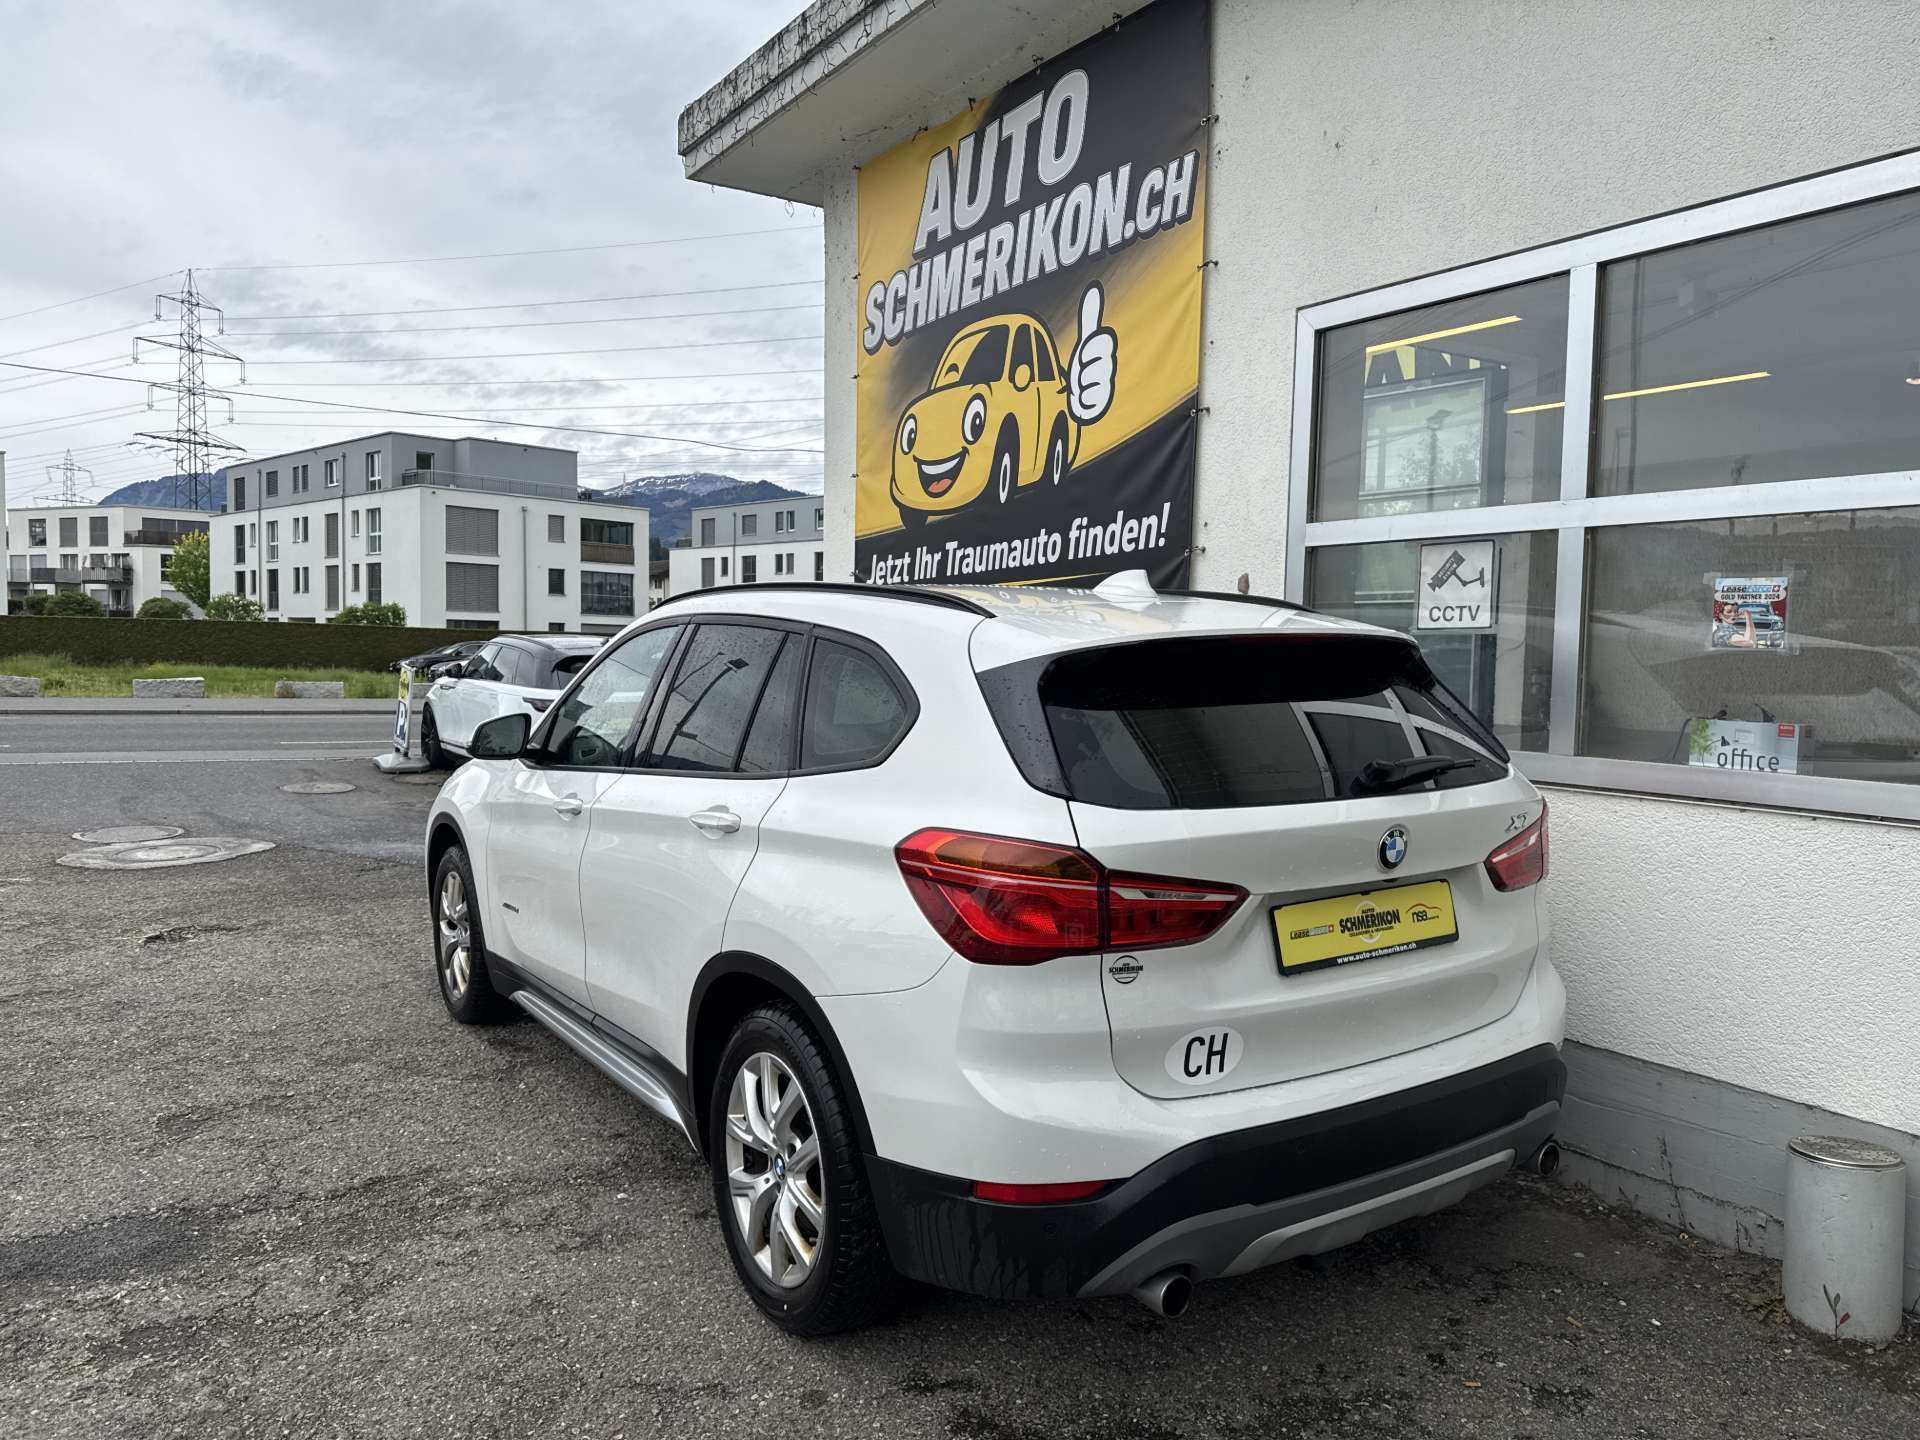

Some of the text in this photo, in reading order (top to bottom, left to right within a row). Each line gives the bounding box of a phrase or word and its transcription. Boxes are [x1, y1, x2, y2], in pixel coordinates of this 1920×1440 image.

[913, 67, 1090, 254] AUTO
[863, 149, 1197, 350] SCHMERIKON.CH
[866, 501, 1171, 585] Jetzt Ihr Traumauto finden!
[1428, 605, 1481, 622] CCTV
[1717, 748, 1780, 771] office
[1339, 909, 1401, 934] SCHMERIKON
[1411, 910, 1428, 923] nsa
[1336, 942, 1417, 965] www.auto-schmerikon.ch
[1183, 1032, 1229, 1078] CH
